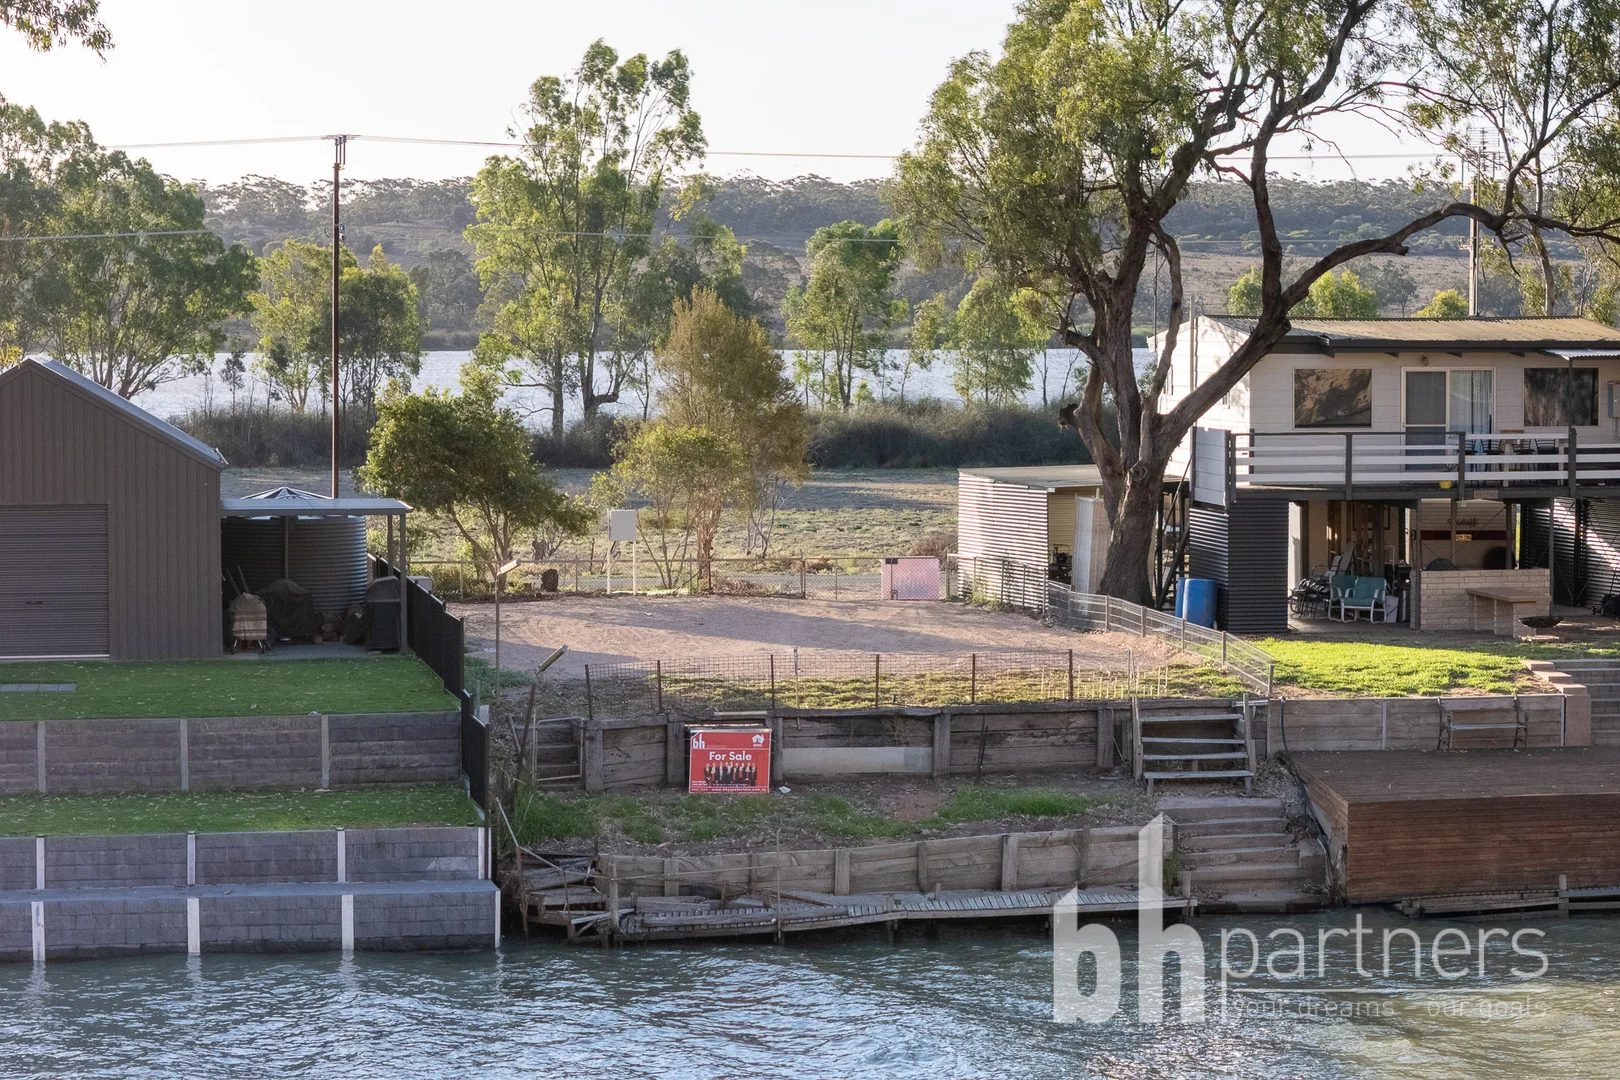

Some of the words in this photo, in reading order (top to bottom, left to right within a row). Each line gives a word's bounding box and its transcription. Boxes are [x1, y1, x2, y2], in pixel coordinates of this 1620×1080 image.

[693, 733, 704, 748] bh
[709, 751, 726, 760] For
[729, 750, 752, 760] Sale
